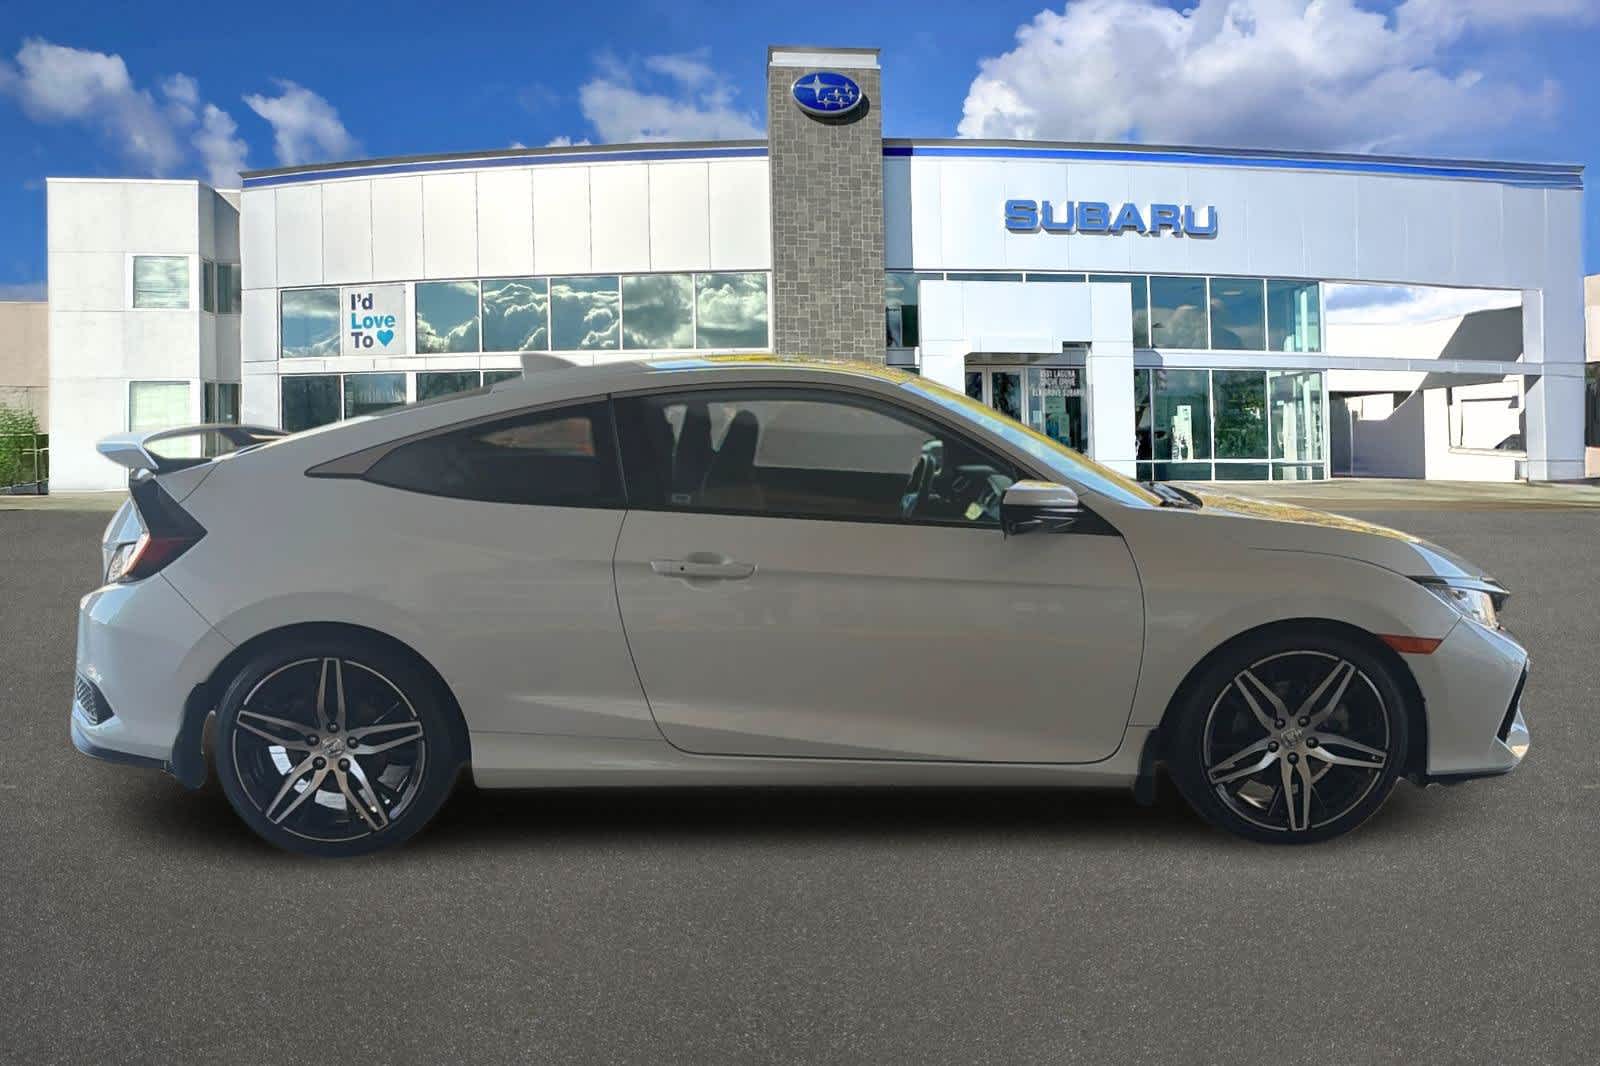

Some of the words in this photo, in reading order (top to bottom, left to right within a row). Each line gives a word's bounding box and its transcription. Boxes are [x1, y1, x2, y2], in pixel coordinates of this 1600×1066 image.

[1005, 199, 1217, 238] SUBARU
[351, 293, 374, 310] I'd
[351, 313, 396, 329] Love
[351, 331, 374, 348] To
